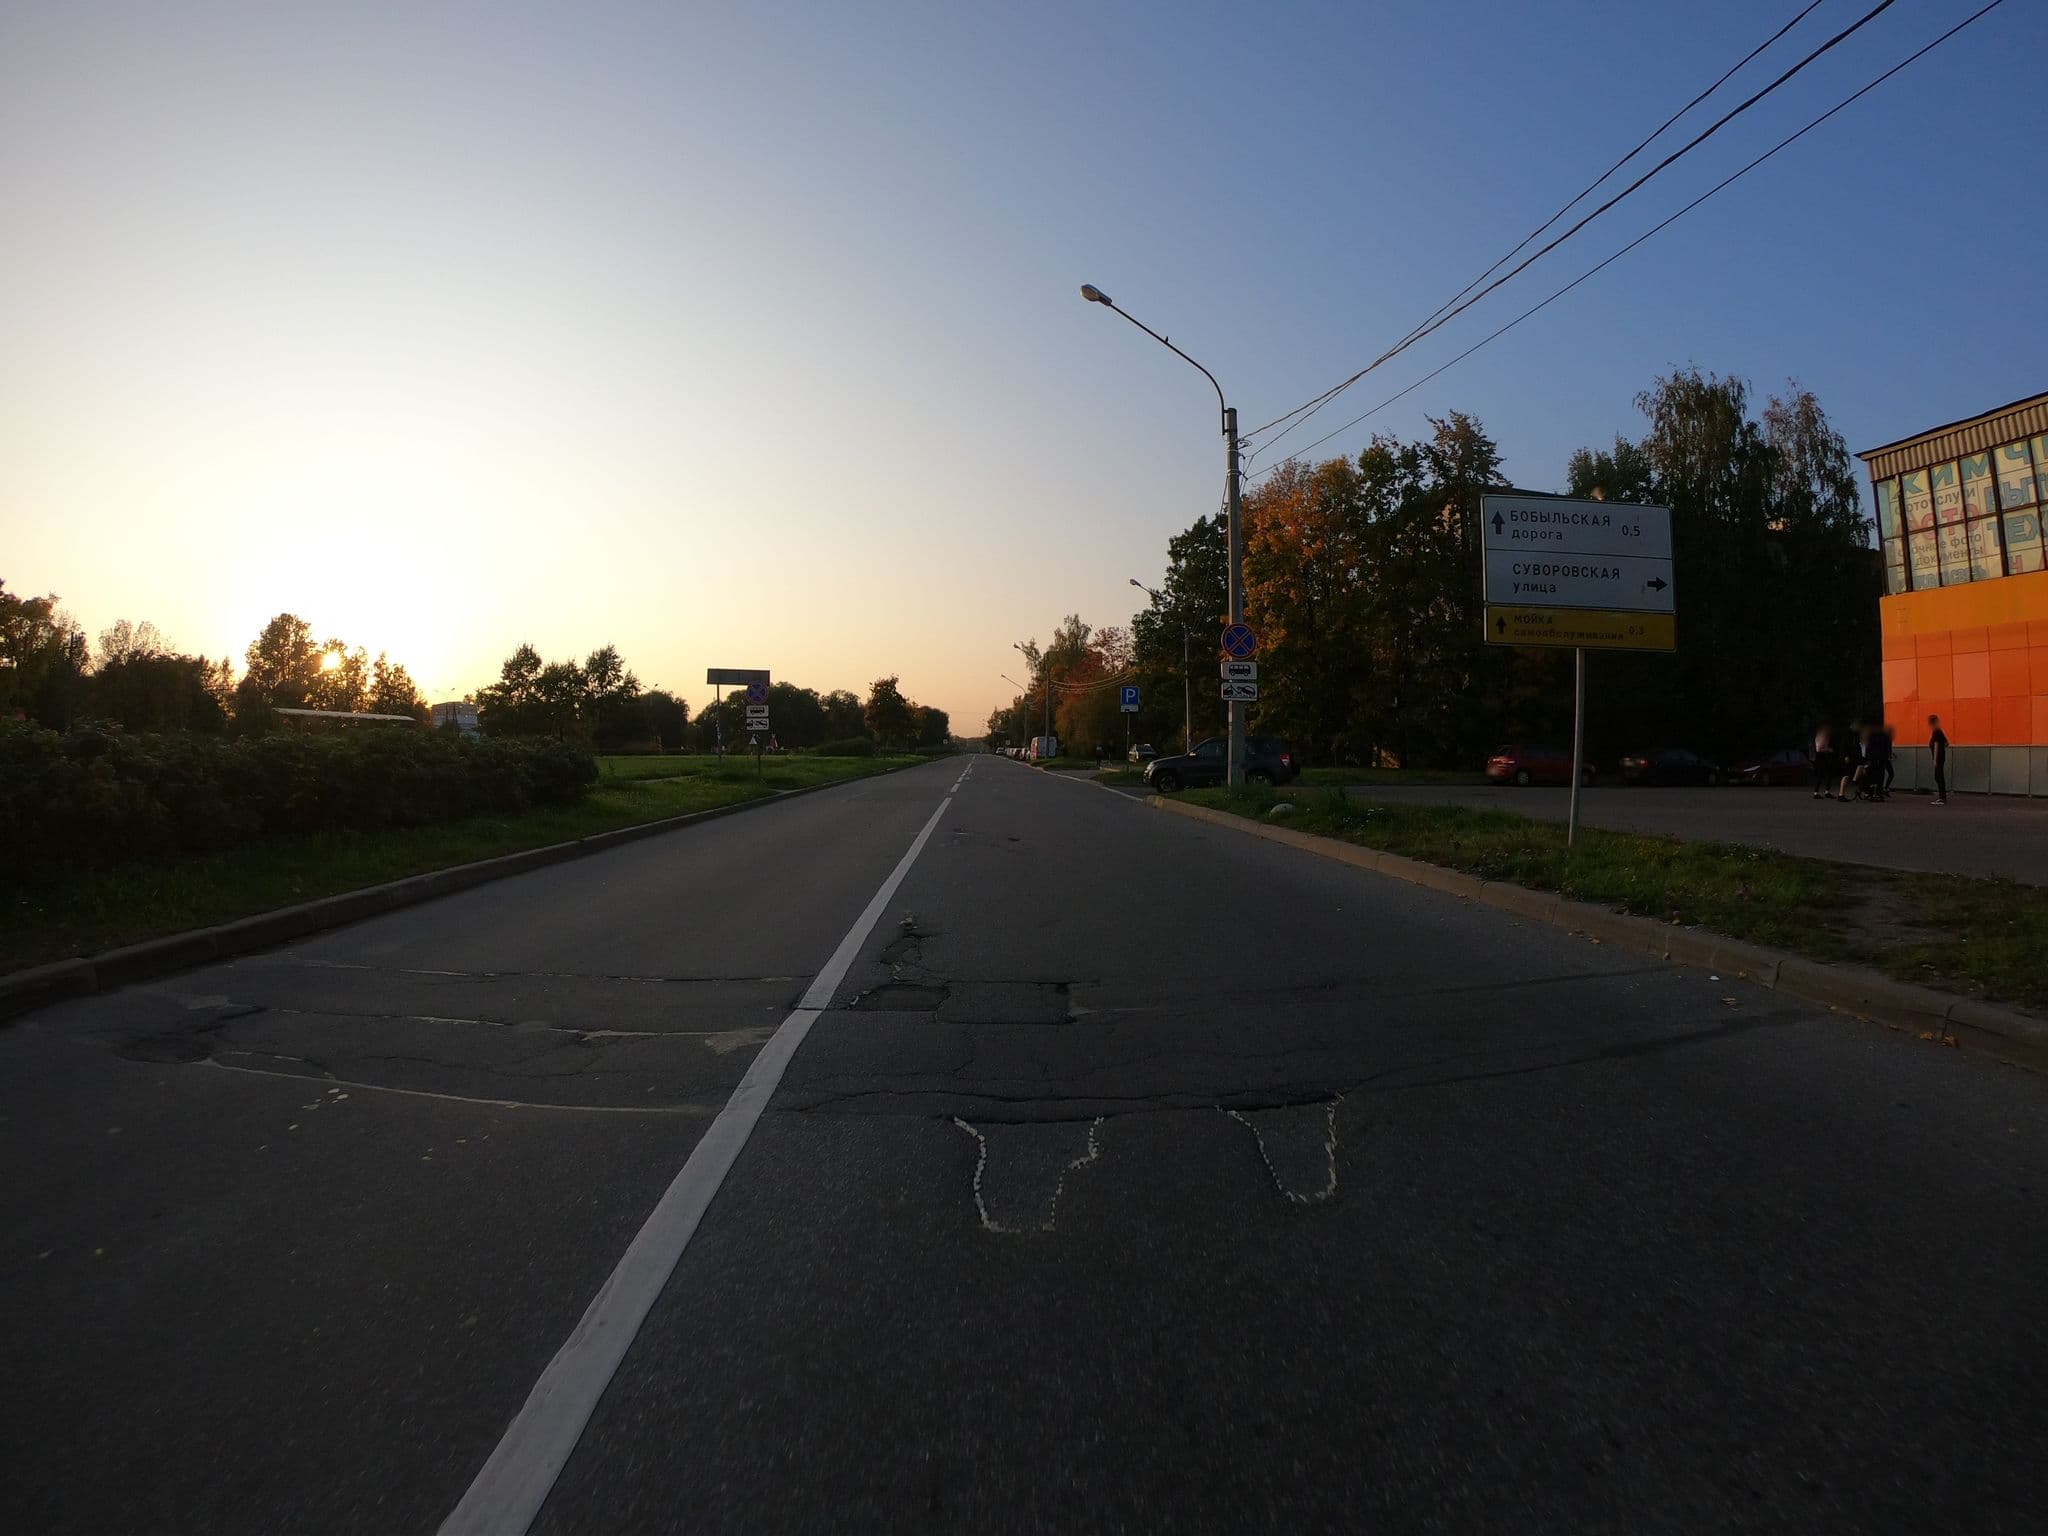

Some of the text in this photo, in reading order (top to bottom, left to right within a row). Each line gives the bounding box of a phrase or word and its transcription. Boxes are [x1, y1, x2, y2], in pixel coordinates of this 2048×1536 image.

[1510, 509, 1611, 527] БОБЫЛЬСКАЯ
[1511, 528, 1563, 542] дорога
[1621, 524, 1641, 537] 0.5
[1513, 563, 1620, 580] СУВОРОВСКАЯ
[1512, 581, 1556, 594] улица
